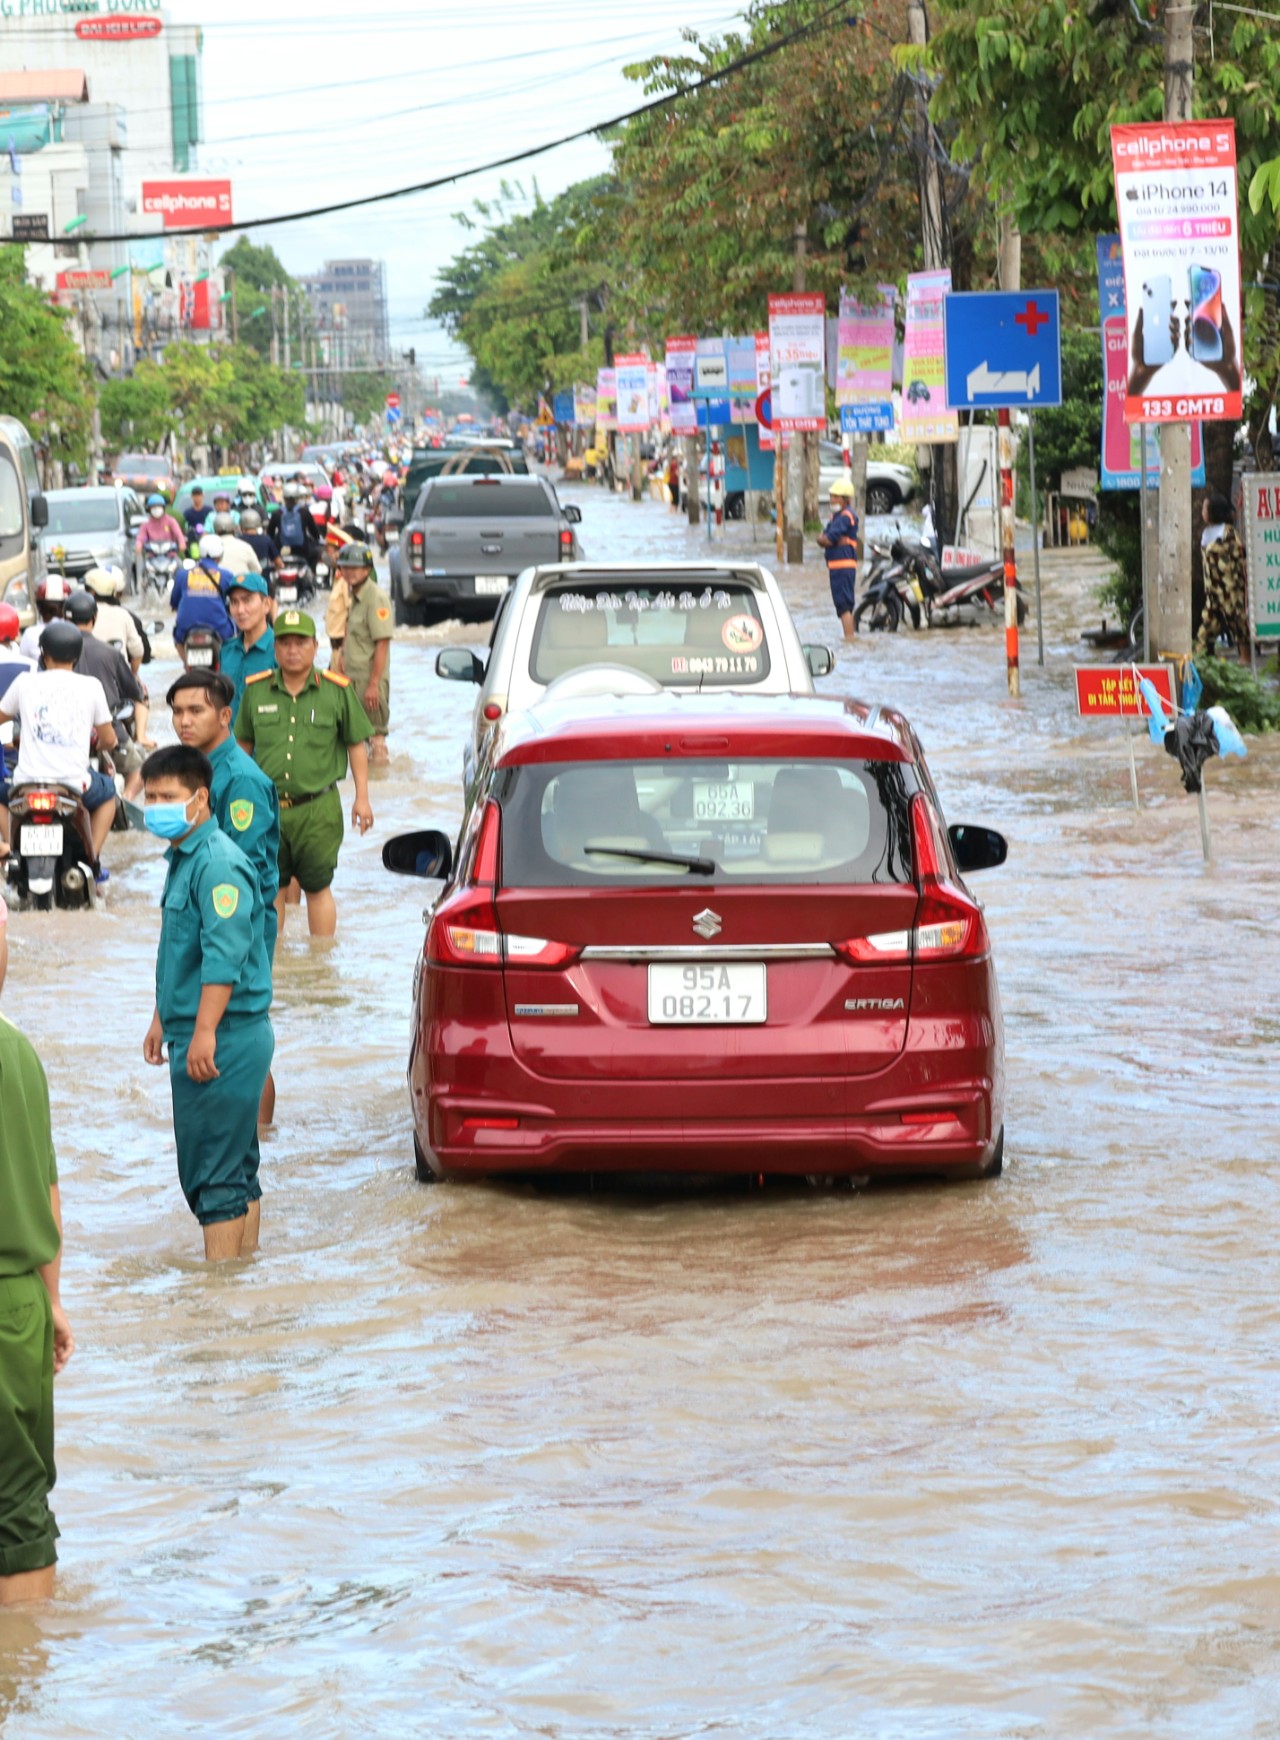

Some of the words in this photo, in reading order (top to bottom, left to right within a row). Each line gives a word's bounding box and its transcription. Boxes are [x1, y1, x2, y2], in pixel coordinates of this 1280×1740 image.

[1116, 135, 1211, 158] cellphone
[1216, 133, 1230, 152] S
[1141, 183, 1205, 200] iPhone
[1208, 180, 1228, 198] 14
[144, 194, 217, 213] cellphone
[219, 193, 230, 211] S
[1182, 220, 1193, 237] 6
[1189, 245, 1196, 255] 7
[1141, 400, 1173, 417] 133
[1176, 397, 1225, 416] CMT8
[696, 801, 751, 817] 092.36
[682, 965, 732, 991] 95A
[662, 995, 752, 1019] 082.17
[844, 998, 905, 1011] ERTIGA
